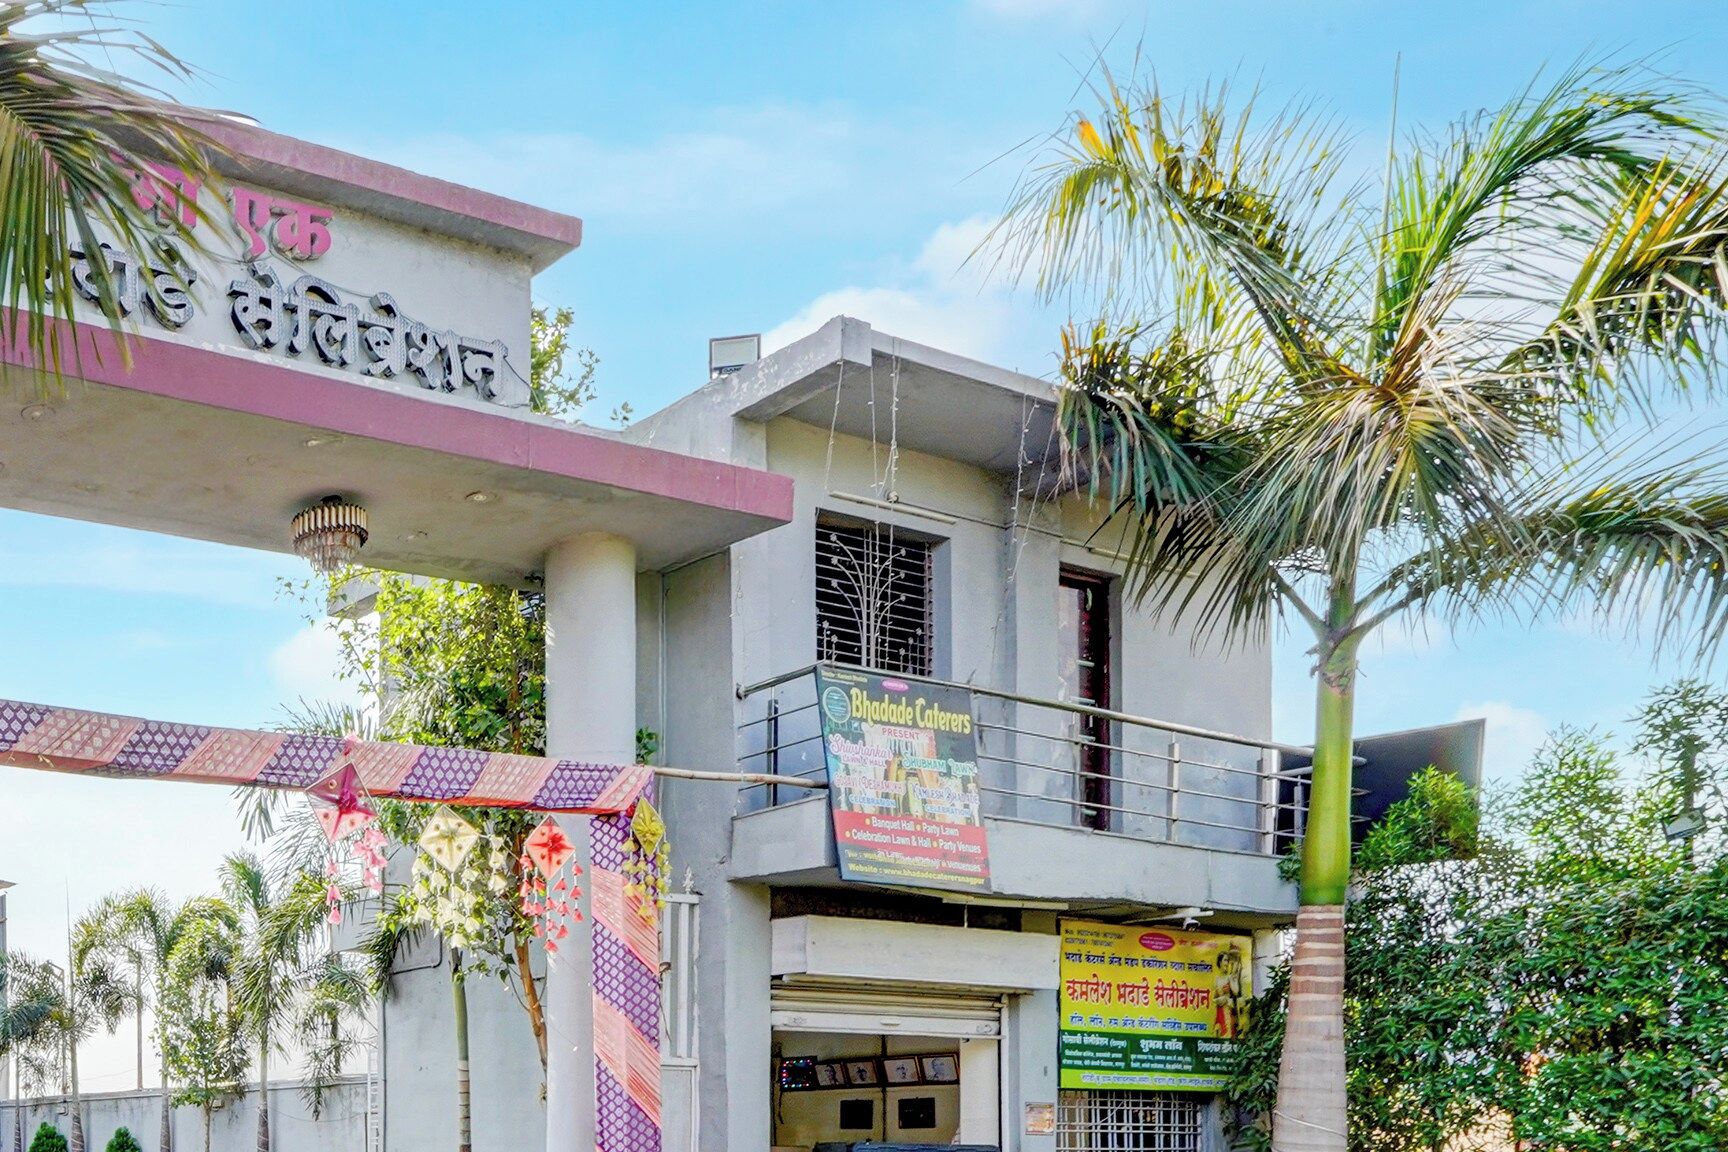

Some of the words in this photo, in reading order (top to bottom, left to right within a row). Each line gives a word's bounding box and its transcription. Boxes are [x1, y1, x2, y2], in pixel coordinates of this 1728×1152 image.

[232, 186, 334, 261] एक
[227, 262, 509, 400] सेलिब्रेशन
[850, 687, 913, 727] Bhadade
[915, 697, 972, 735] Caterers
[882, 727, 920, 740] PRESENT
[903, 753, 947, 772] SHUBHAM
[872, 816, 900, 831] Banquet
[901, 818, 914, 831] Hall
[923, 822, 940, 836] Party
[941, 825, 959, 836] Lawn
[851, 828, 891, 844] Celebration
[892, 833, 910, 845] Lawn
[911, 835, 917, 846] &
[918, 836, 932, 848] Hall
[939, 839, 957, 852] Party
[958, 840, 981, 854] Venues
[848, 863, 878, 874] Website
[1065, 973, 1113, 1004] कमलेश
[1117, 976, 1150, 1008] भदाडे
